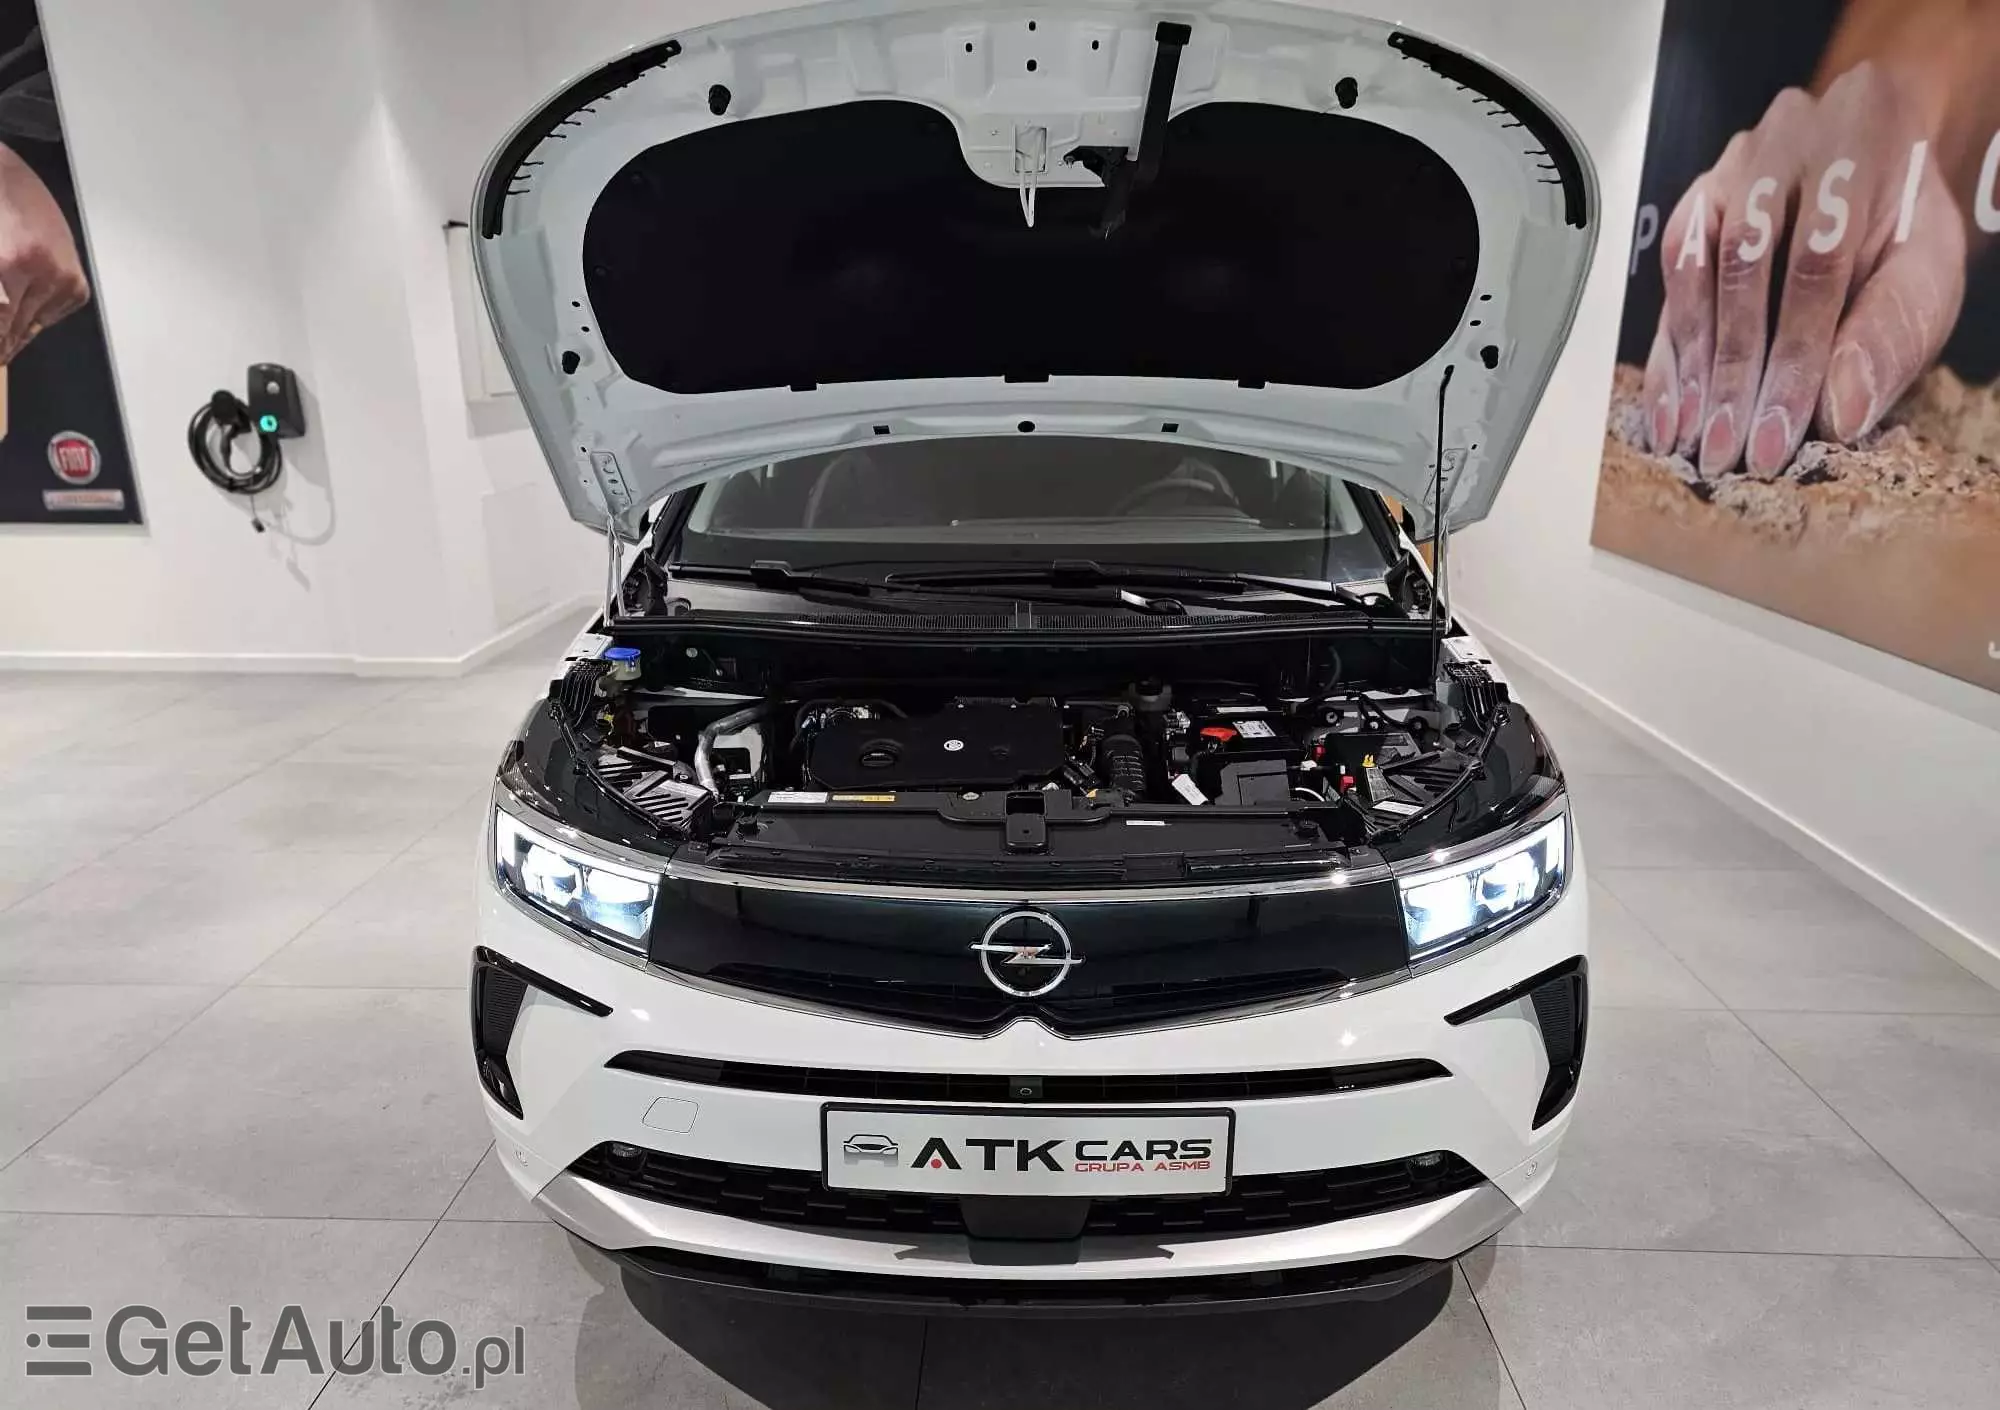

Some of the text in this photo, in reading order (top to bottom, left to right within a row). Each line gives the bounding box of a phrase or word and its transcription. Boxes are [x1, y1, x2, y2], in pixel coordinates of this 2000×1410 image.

[910, 1137, 1212, 1171] ATK CARS
[1075, 1160, 1211, 1173] GRUPA ASMB
